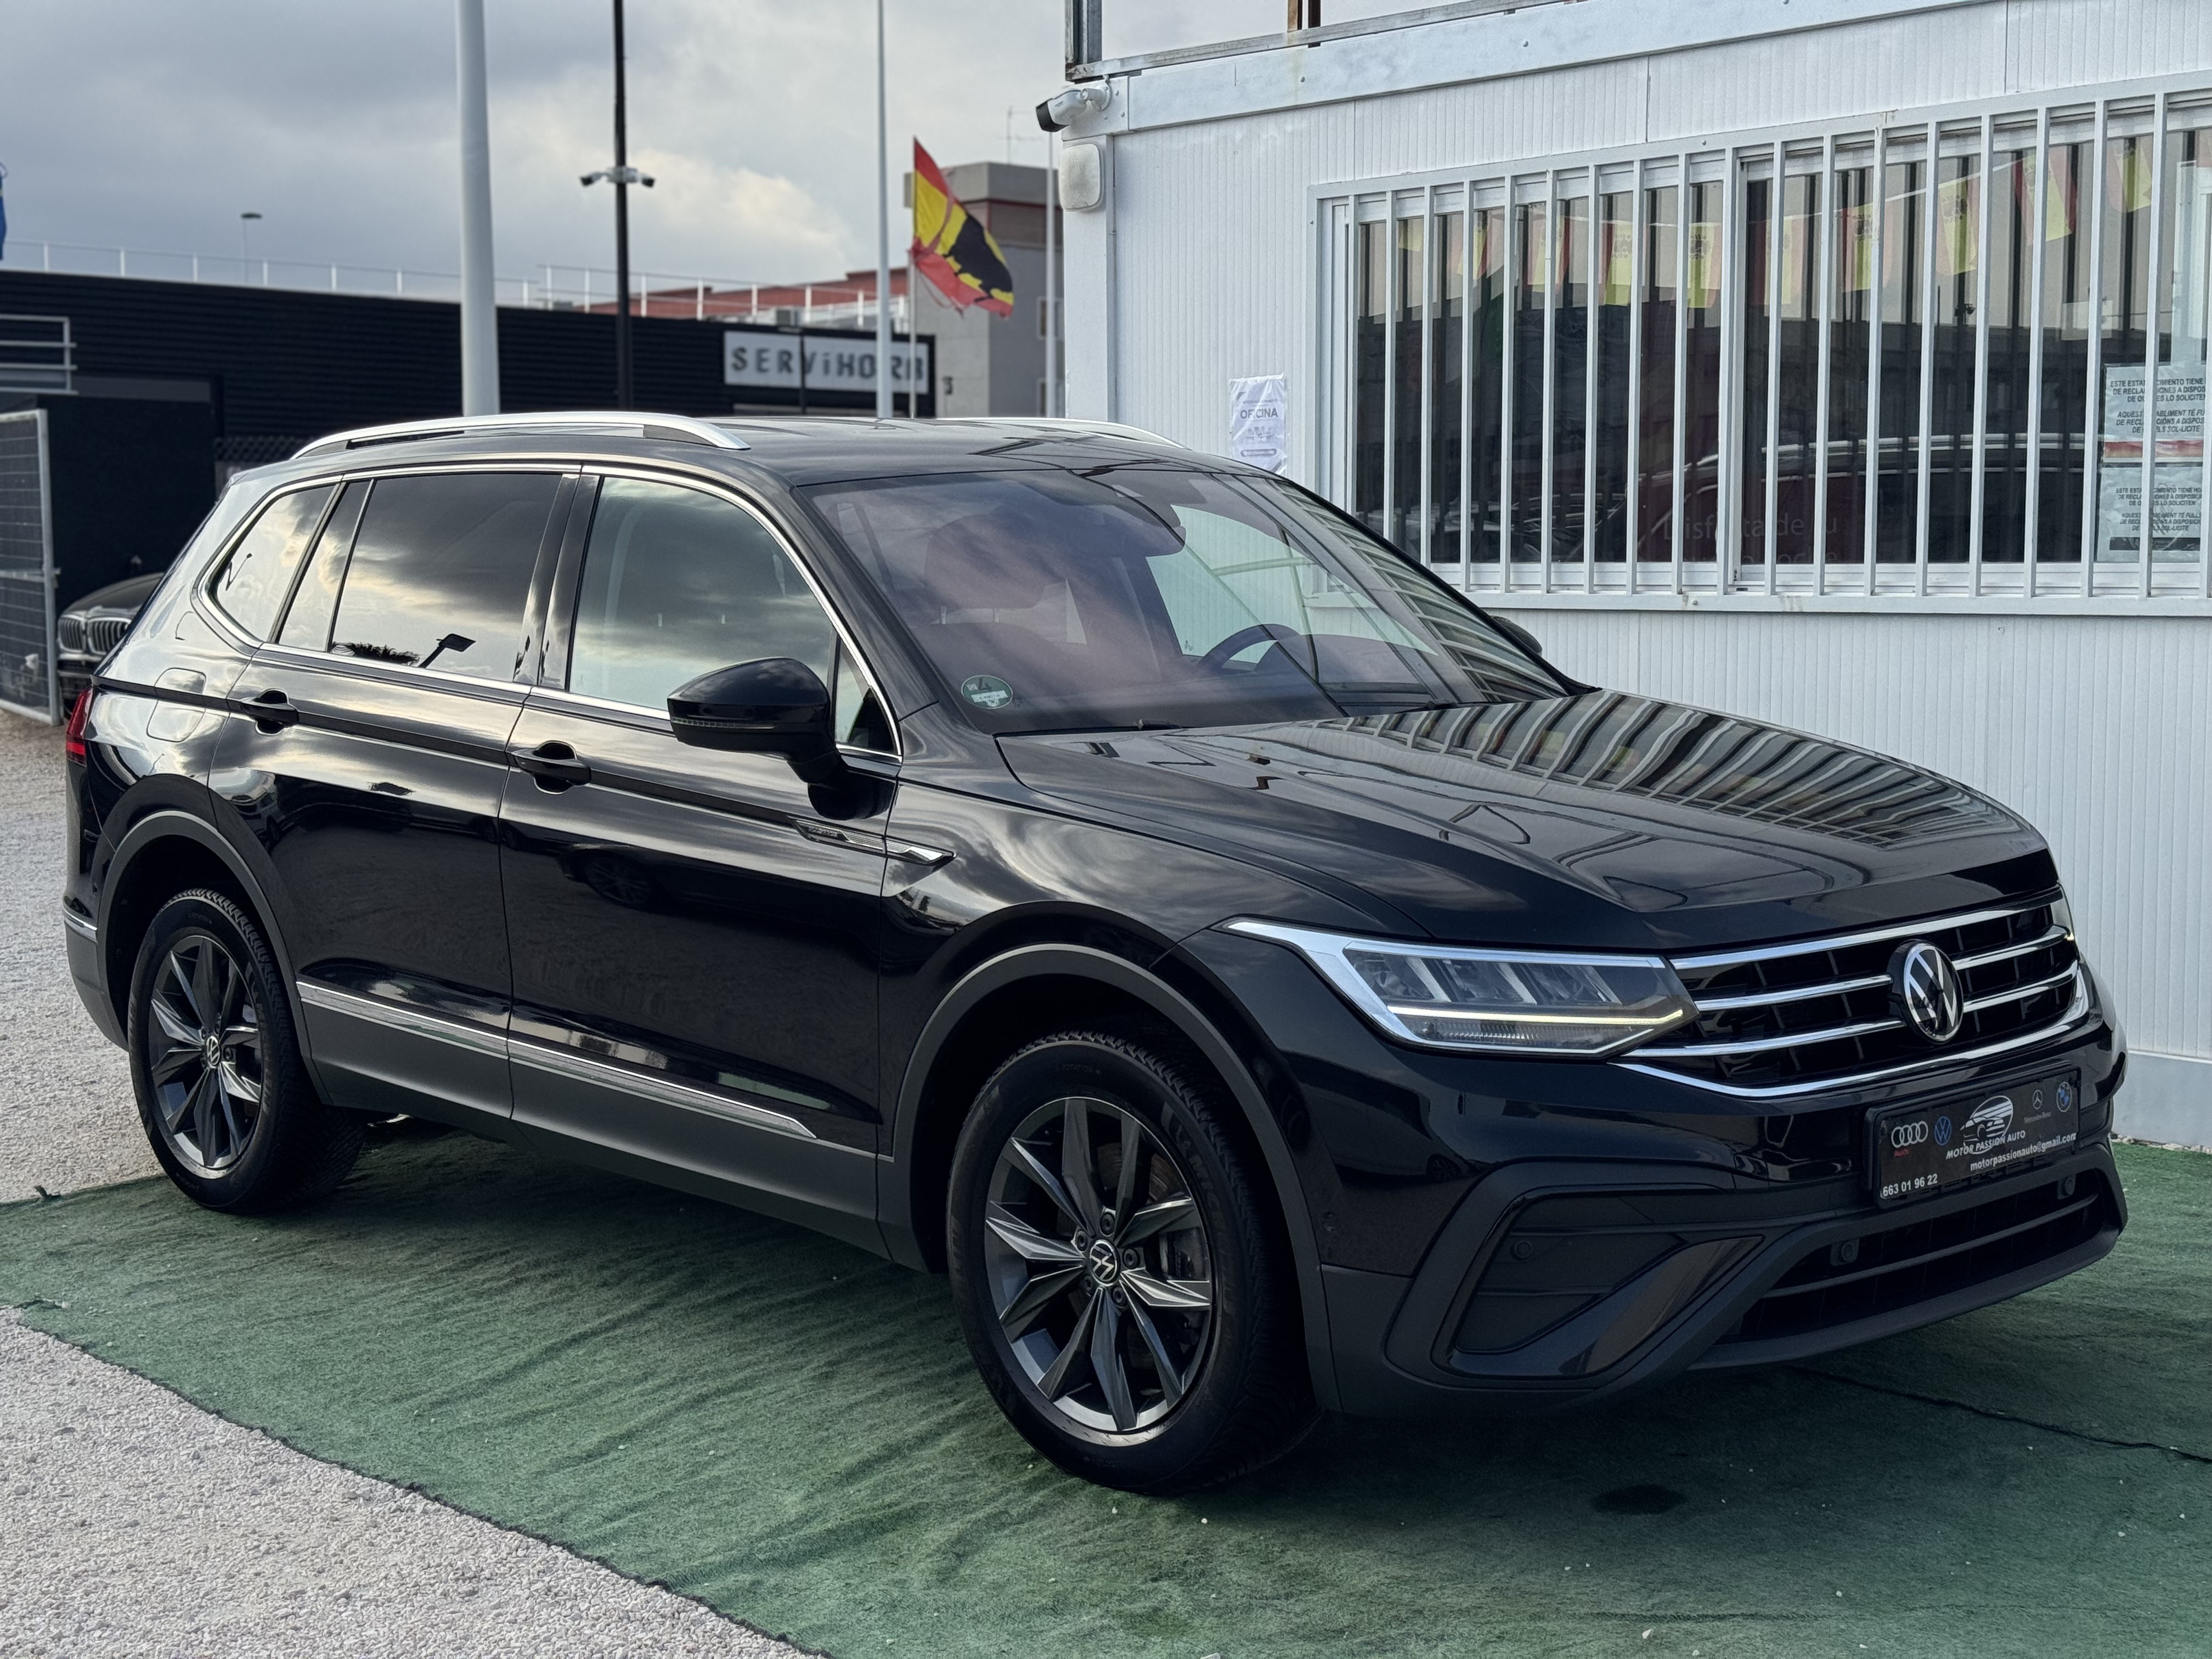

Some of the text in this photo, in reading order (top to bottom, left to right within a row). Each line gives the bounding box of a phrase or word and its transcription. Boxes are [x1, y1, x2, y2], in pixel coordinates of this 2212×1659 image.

[1946, 1130, 2026, 1160] MOTOR PASSION AUTO
[1970, 1132, 2077, 1172] motorpassionauto@gmail.com
[1883, 1173, 1938, 1197] 663 01 96 22
